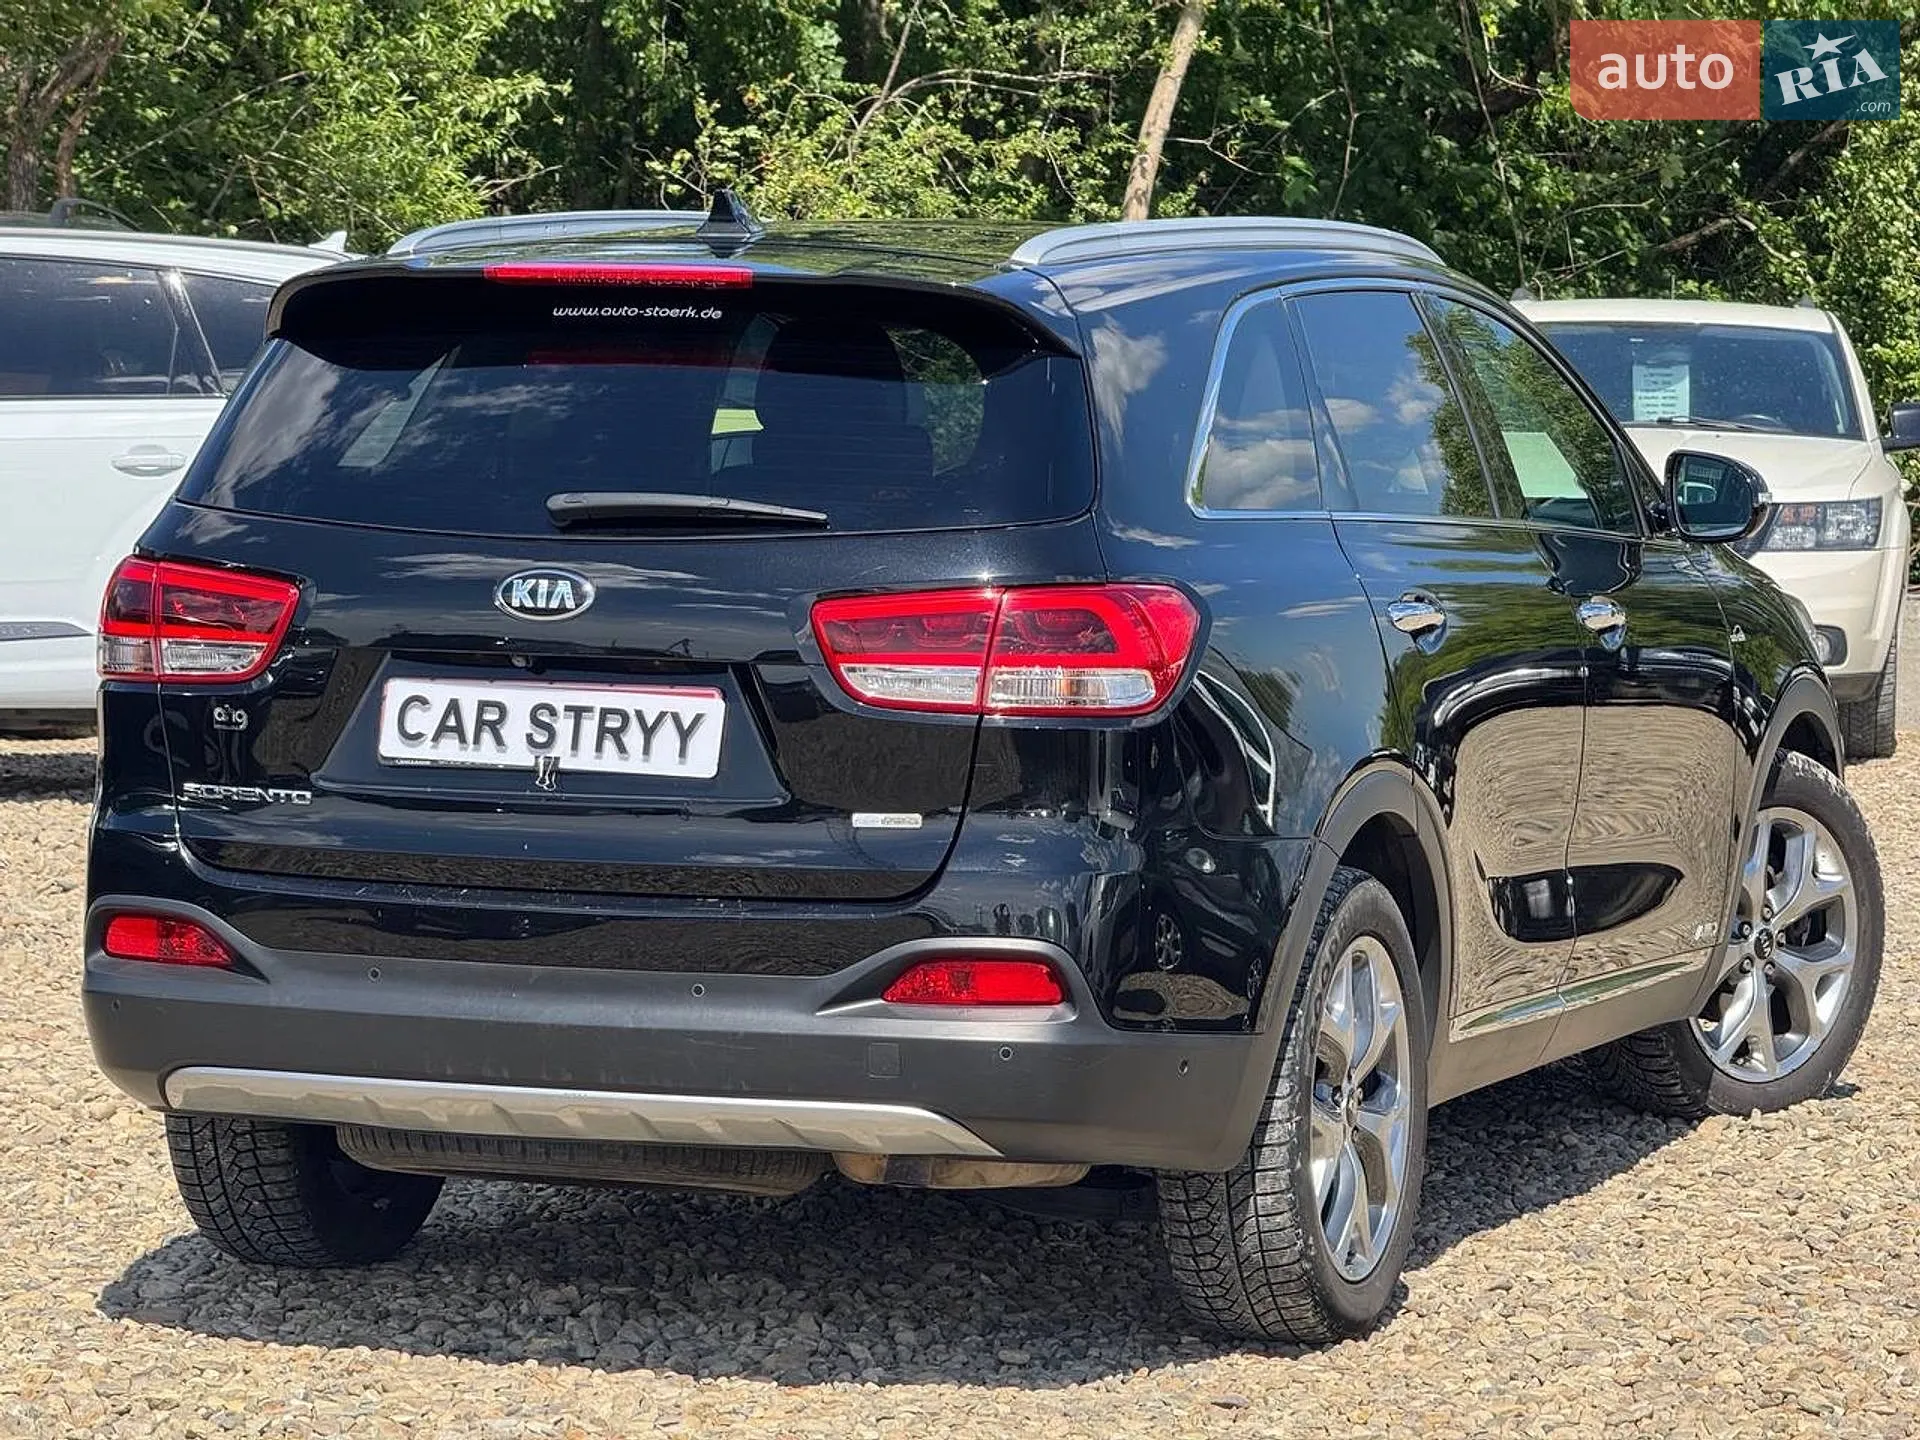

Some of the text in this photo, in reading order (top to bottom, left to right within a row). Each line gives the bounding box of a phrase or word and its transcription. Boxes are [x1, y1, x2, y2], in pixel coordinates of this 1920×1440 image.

[552, 305, 723, 319] www.auto-stoerk.de
[511, 578, 577, 609] KIA
[396, 693, 707, 762] CAR STRYY
[182, 782, 313, 806] SORENTO
